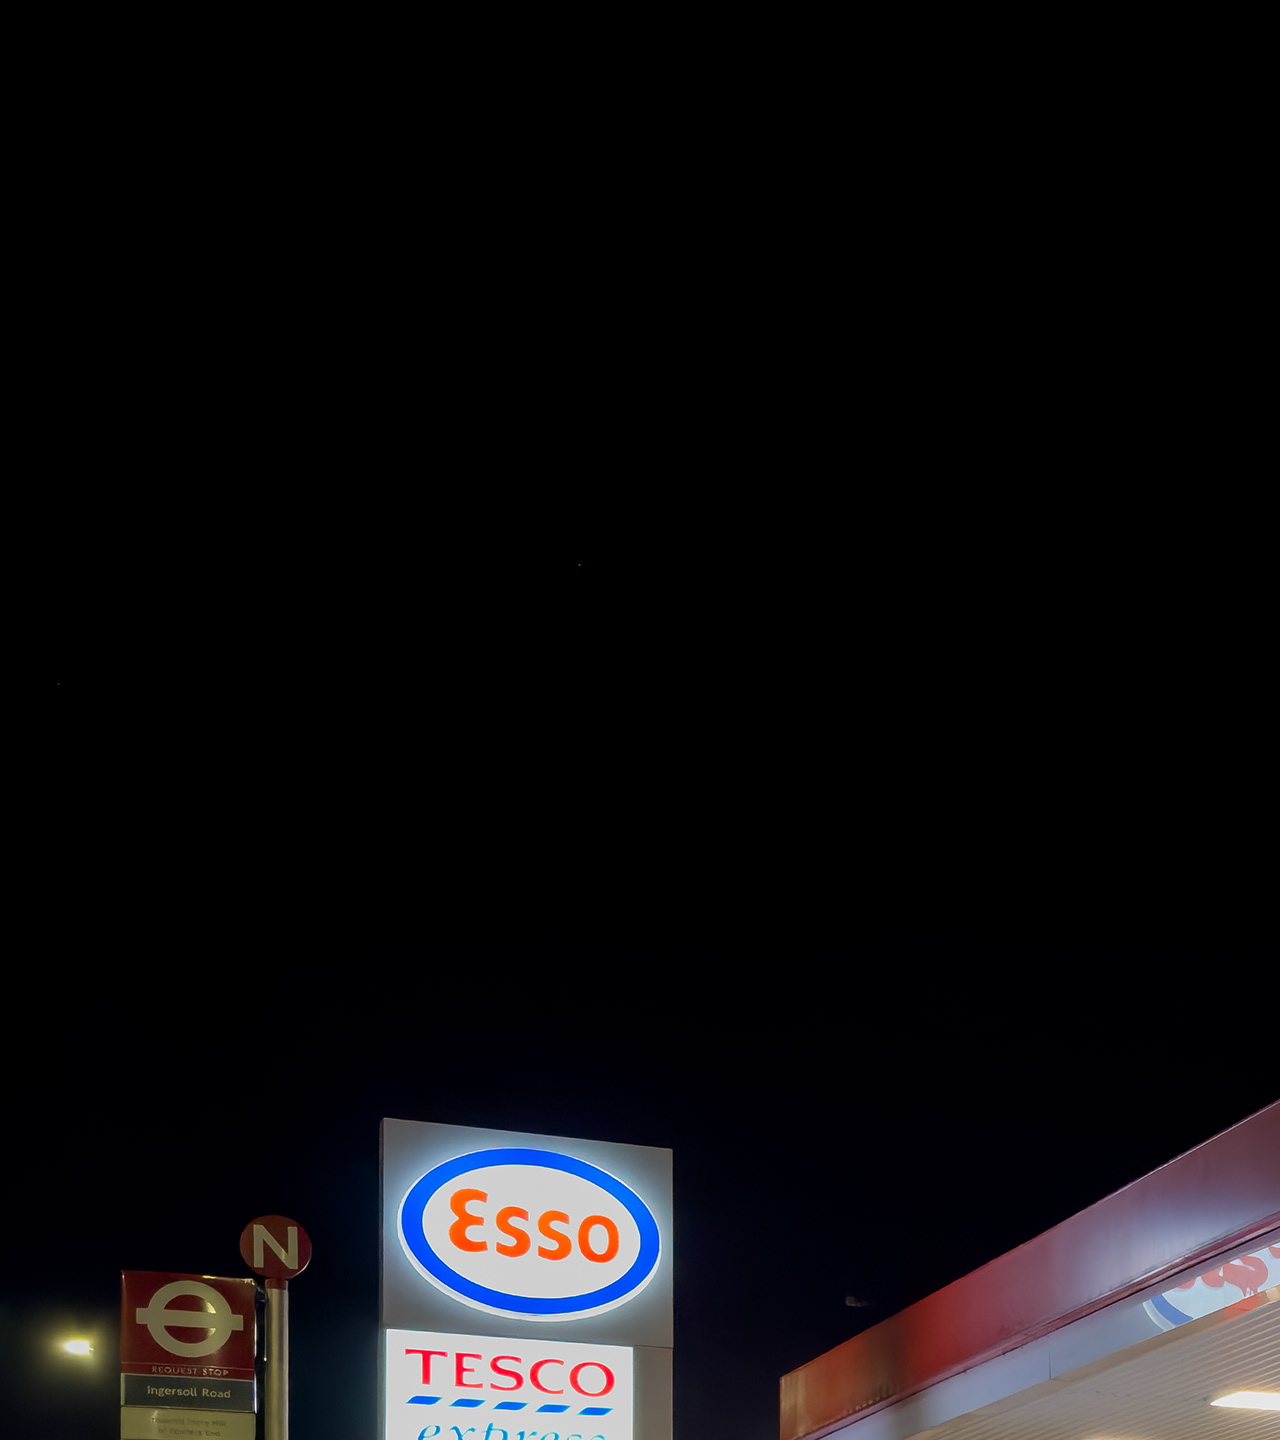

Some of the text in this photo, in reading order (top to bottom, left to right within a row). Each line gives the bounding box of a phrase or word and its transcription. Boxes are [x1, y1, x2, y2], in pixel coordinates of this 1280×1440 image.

[253, 1224, 298, 1270] N
[152, 1366, 229, 1377] REQUEST STOP
[404, 1348, 616, 1397] TESCO
[147, 1385, 231, 1399] Ingersoll Road
